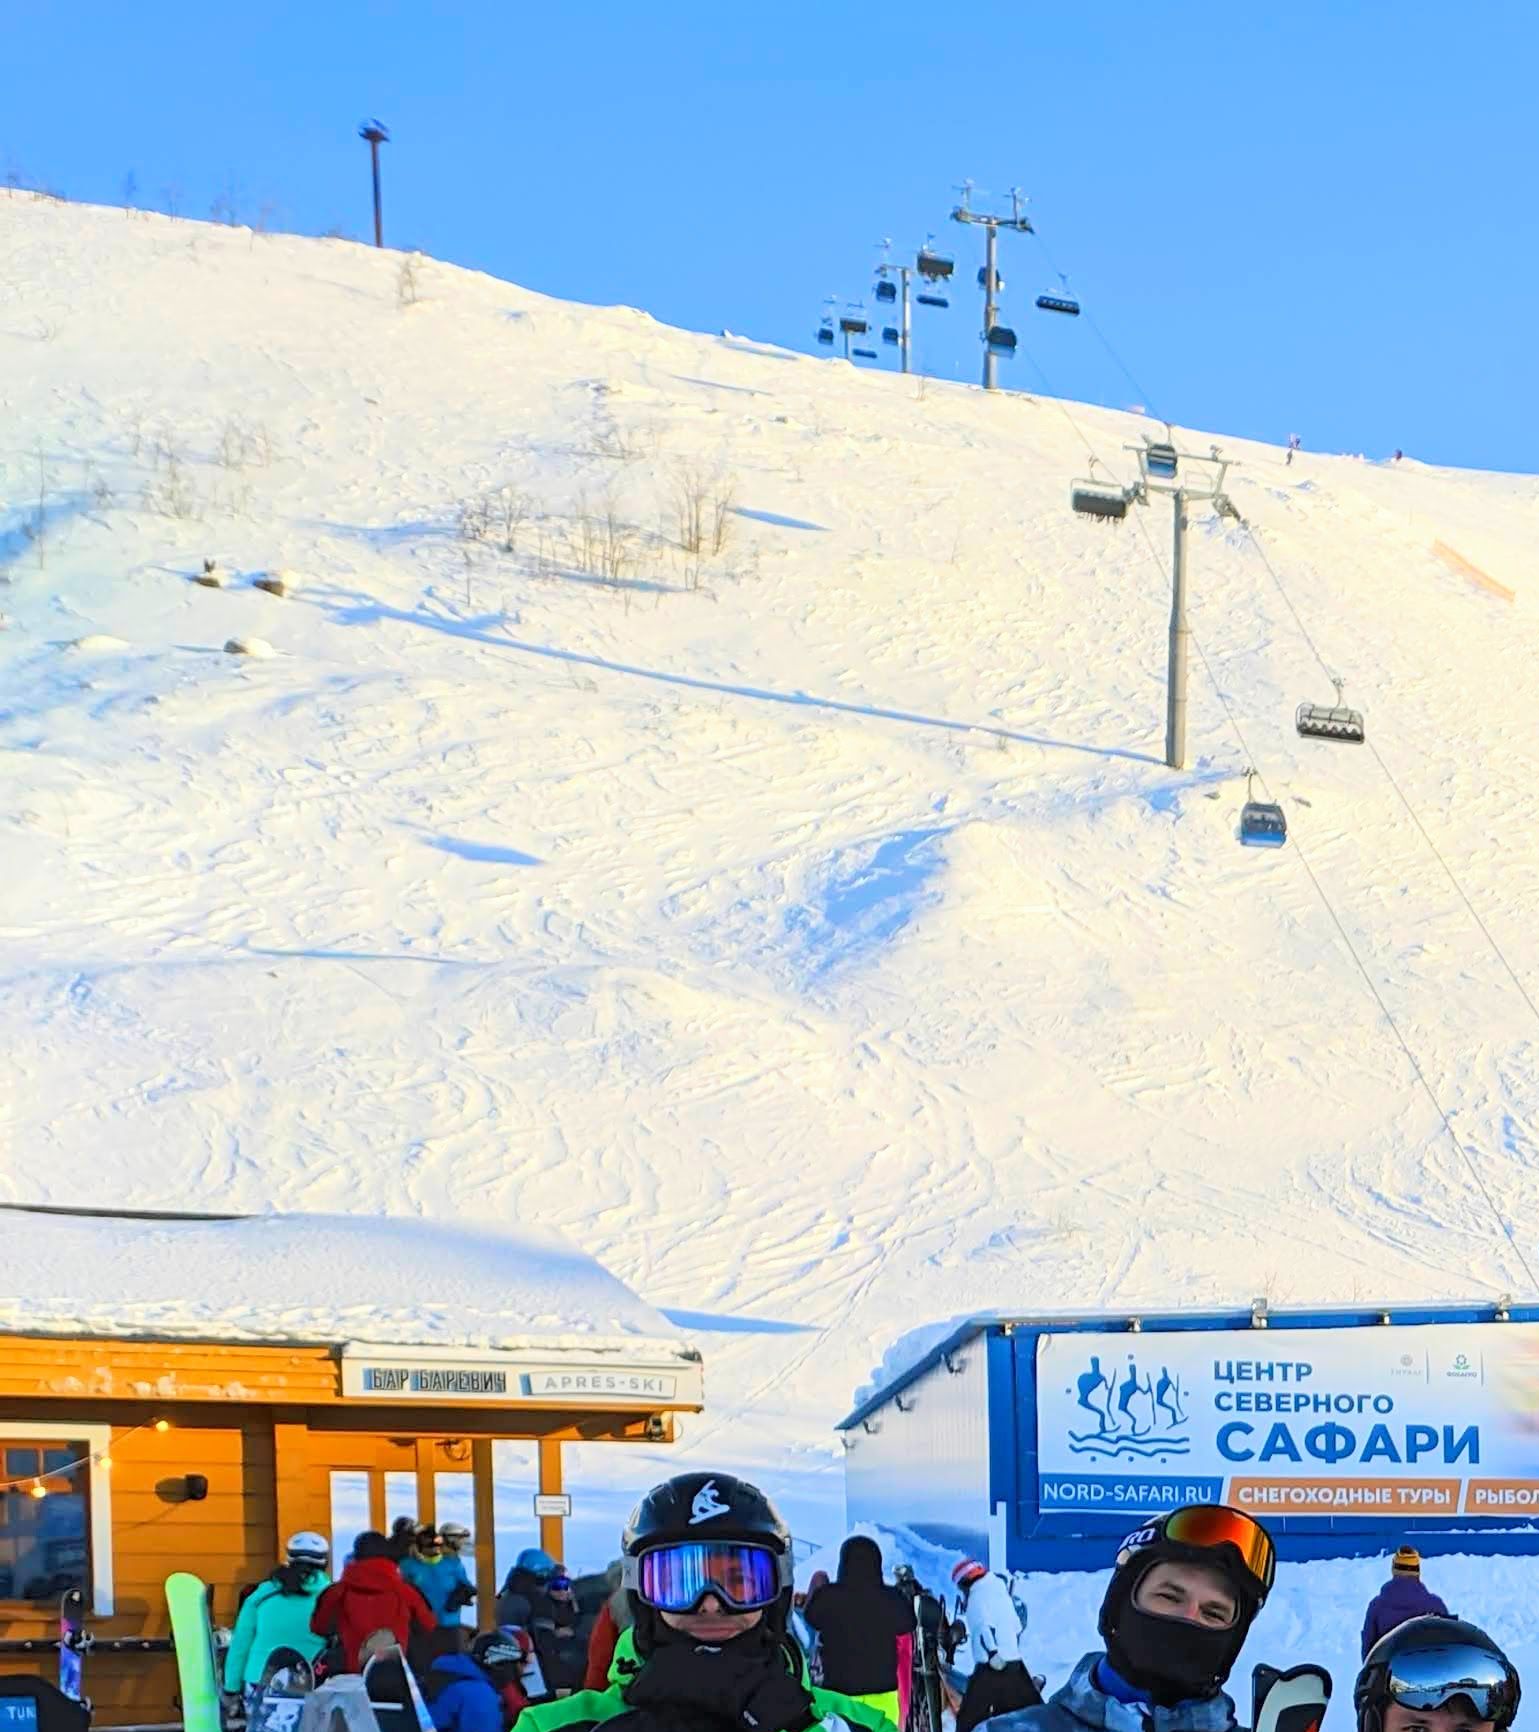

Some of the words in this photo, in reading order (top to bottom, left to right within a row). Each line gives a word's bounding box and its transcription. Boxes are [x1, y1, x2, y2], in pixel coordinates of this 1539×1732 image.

[371, 1367, 410, 1391] БАР
[418, 1370, 507, 1393] БАРЕВИЧ
[1213, 1359, 1313, 1385] ЦЕНТР
[1213, 1390, 1394, 1414] СЕВЕРНОГО
[1215, 1420, 1481, 1465] САФАРИ
[1043, 1482, 1213, 1504] NORD-SAFARI.RU
[1238, 1486, 1393, 1505] СНЕГОХОДНЫЕ
[1397, 1487, 1452, 1507] ТУРЫ
